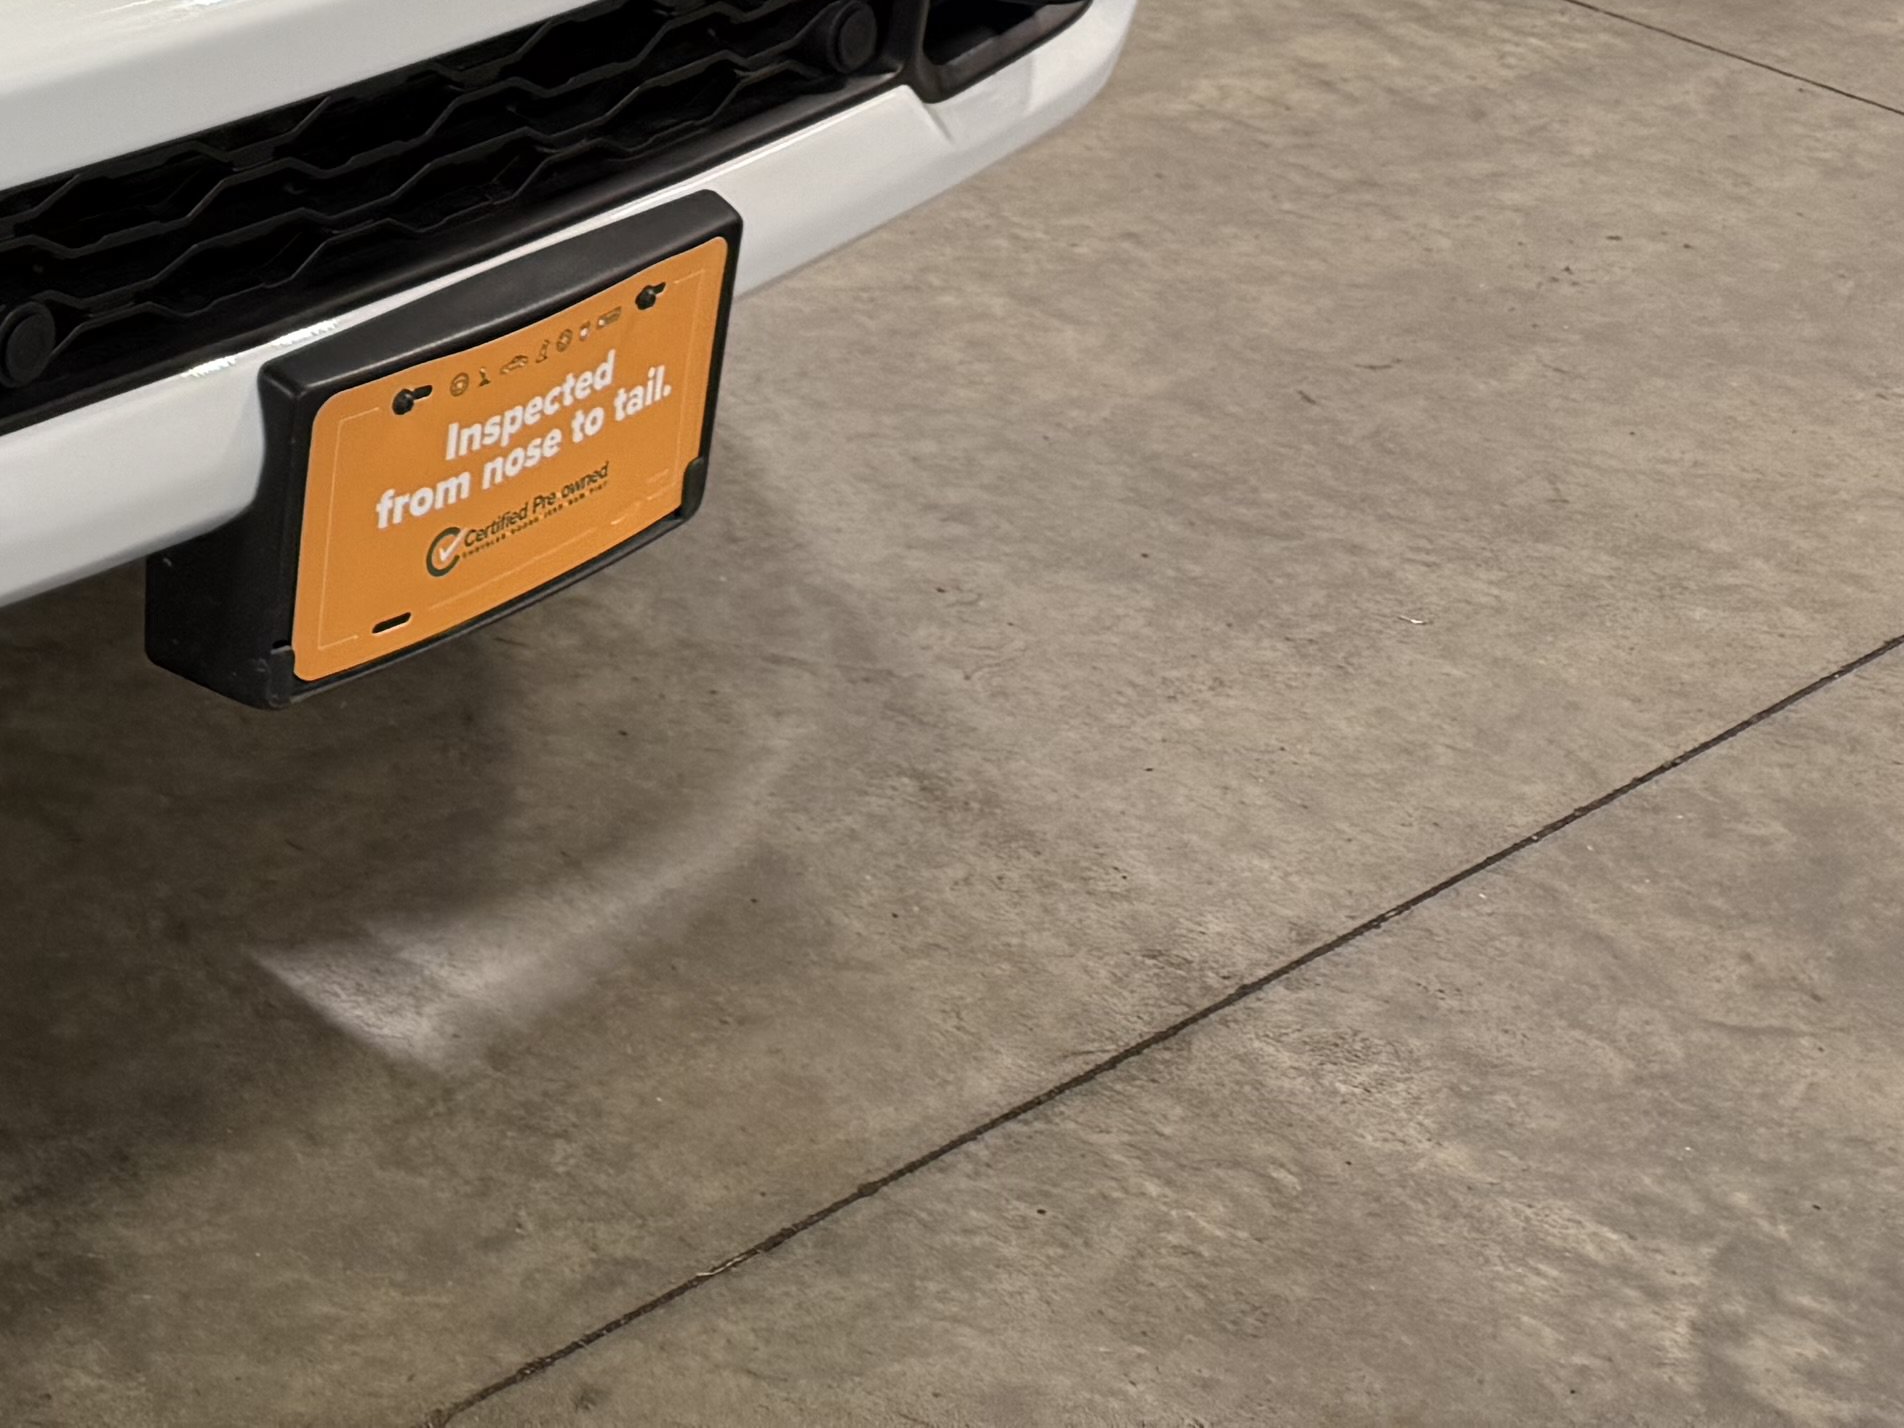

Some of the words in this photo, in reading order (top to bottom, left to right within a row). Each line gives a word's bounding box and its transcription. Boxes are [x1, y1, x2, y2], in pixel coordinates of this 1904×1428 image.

[376, 470, 472, 530] from
[481, 427, 563, 491] nose
[571, 406, 606, 444] to
[614, 364, 673, 423] tail.
[446, 348, 617, 461] Inspected
[464, 501, 529, 547] Certified
